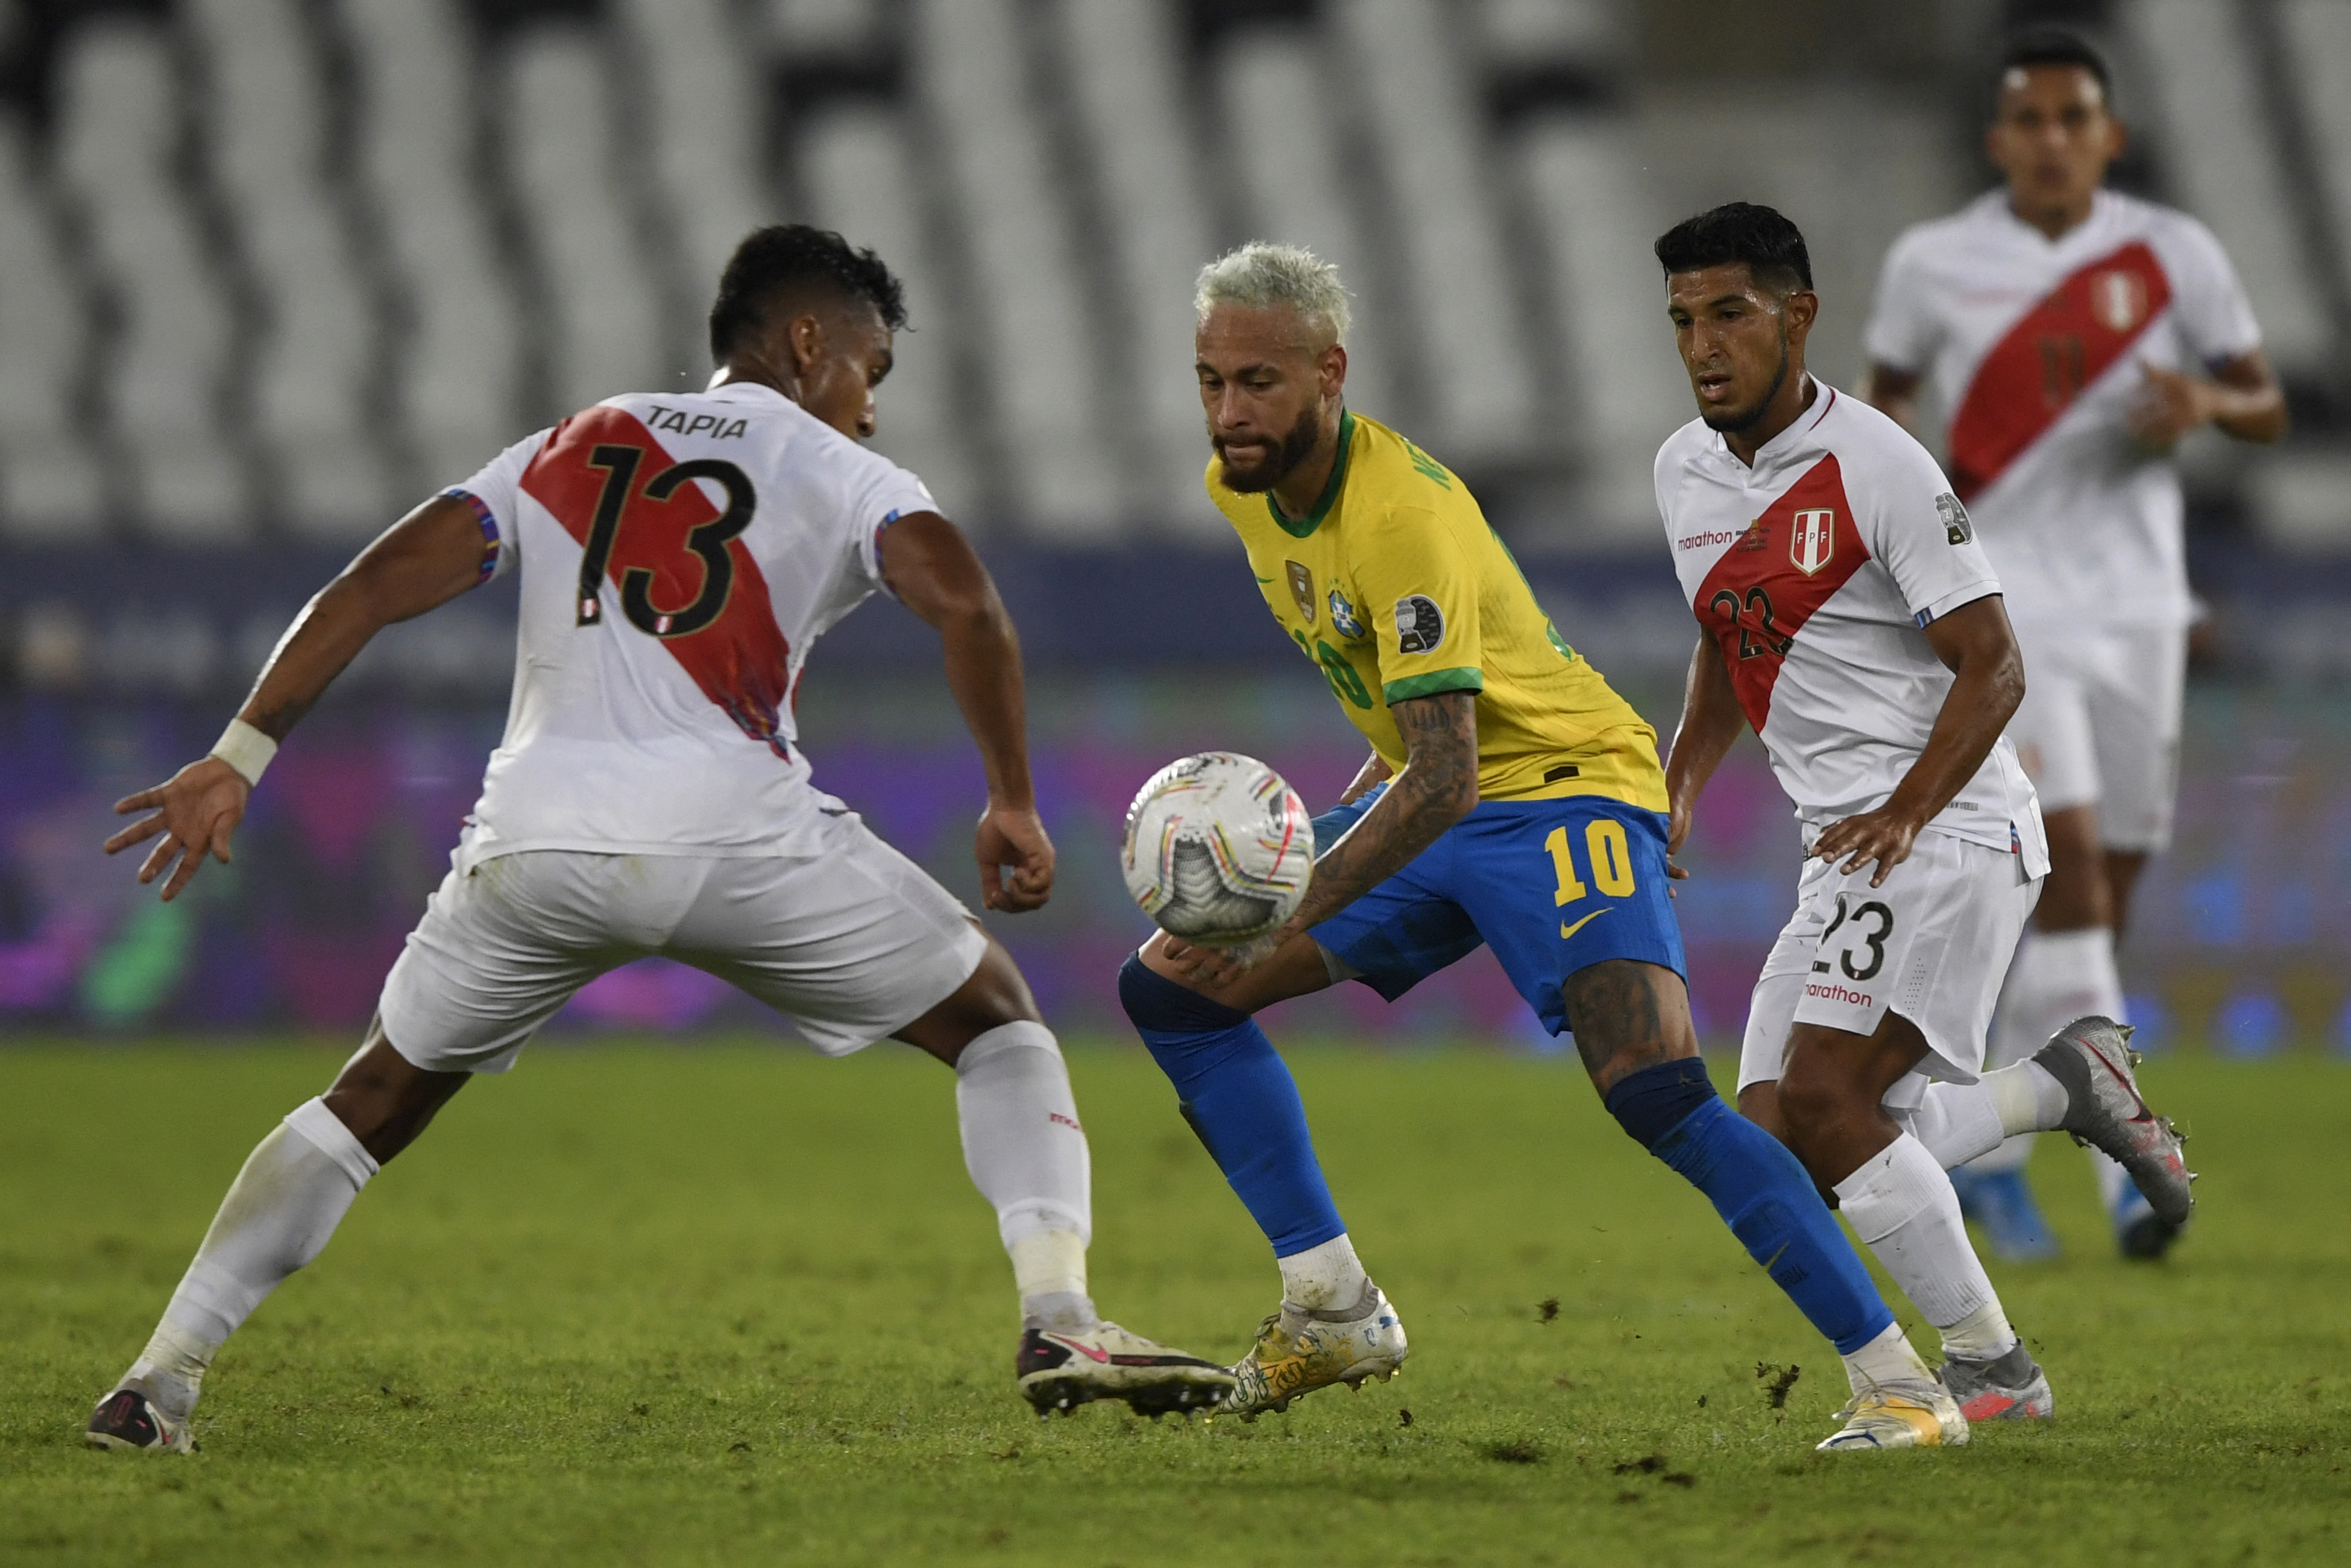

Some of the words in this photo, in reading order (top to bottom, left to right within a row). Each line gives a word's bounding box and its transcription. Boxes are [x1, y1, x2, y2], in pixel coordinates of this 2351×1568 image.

[647, 405, 748, 439] TAPIA
[576, 444, 757, 638] 13
[1678, 530, 1732, 552] marathon
[1796, 531, 1827, 544] FPF
[1710, 585, 1795, 660] 23
[1544, 818, 1636, 908] 10
